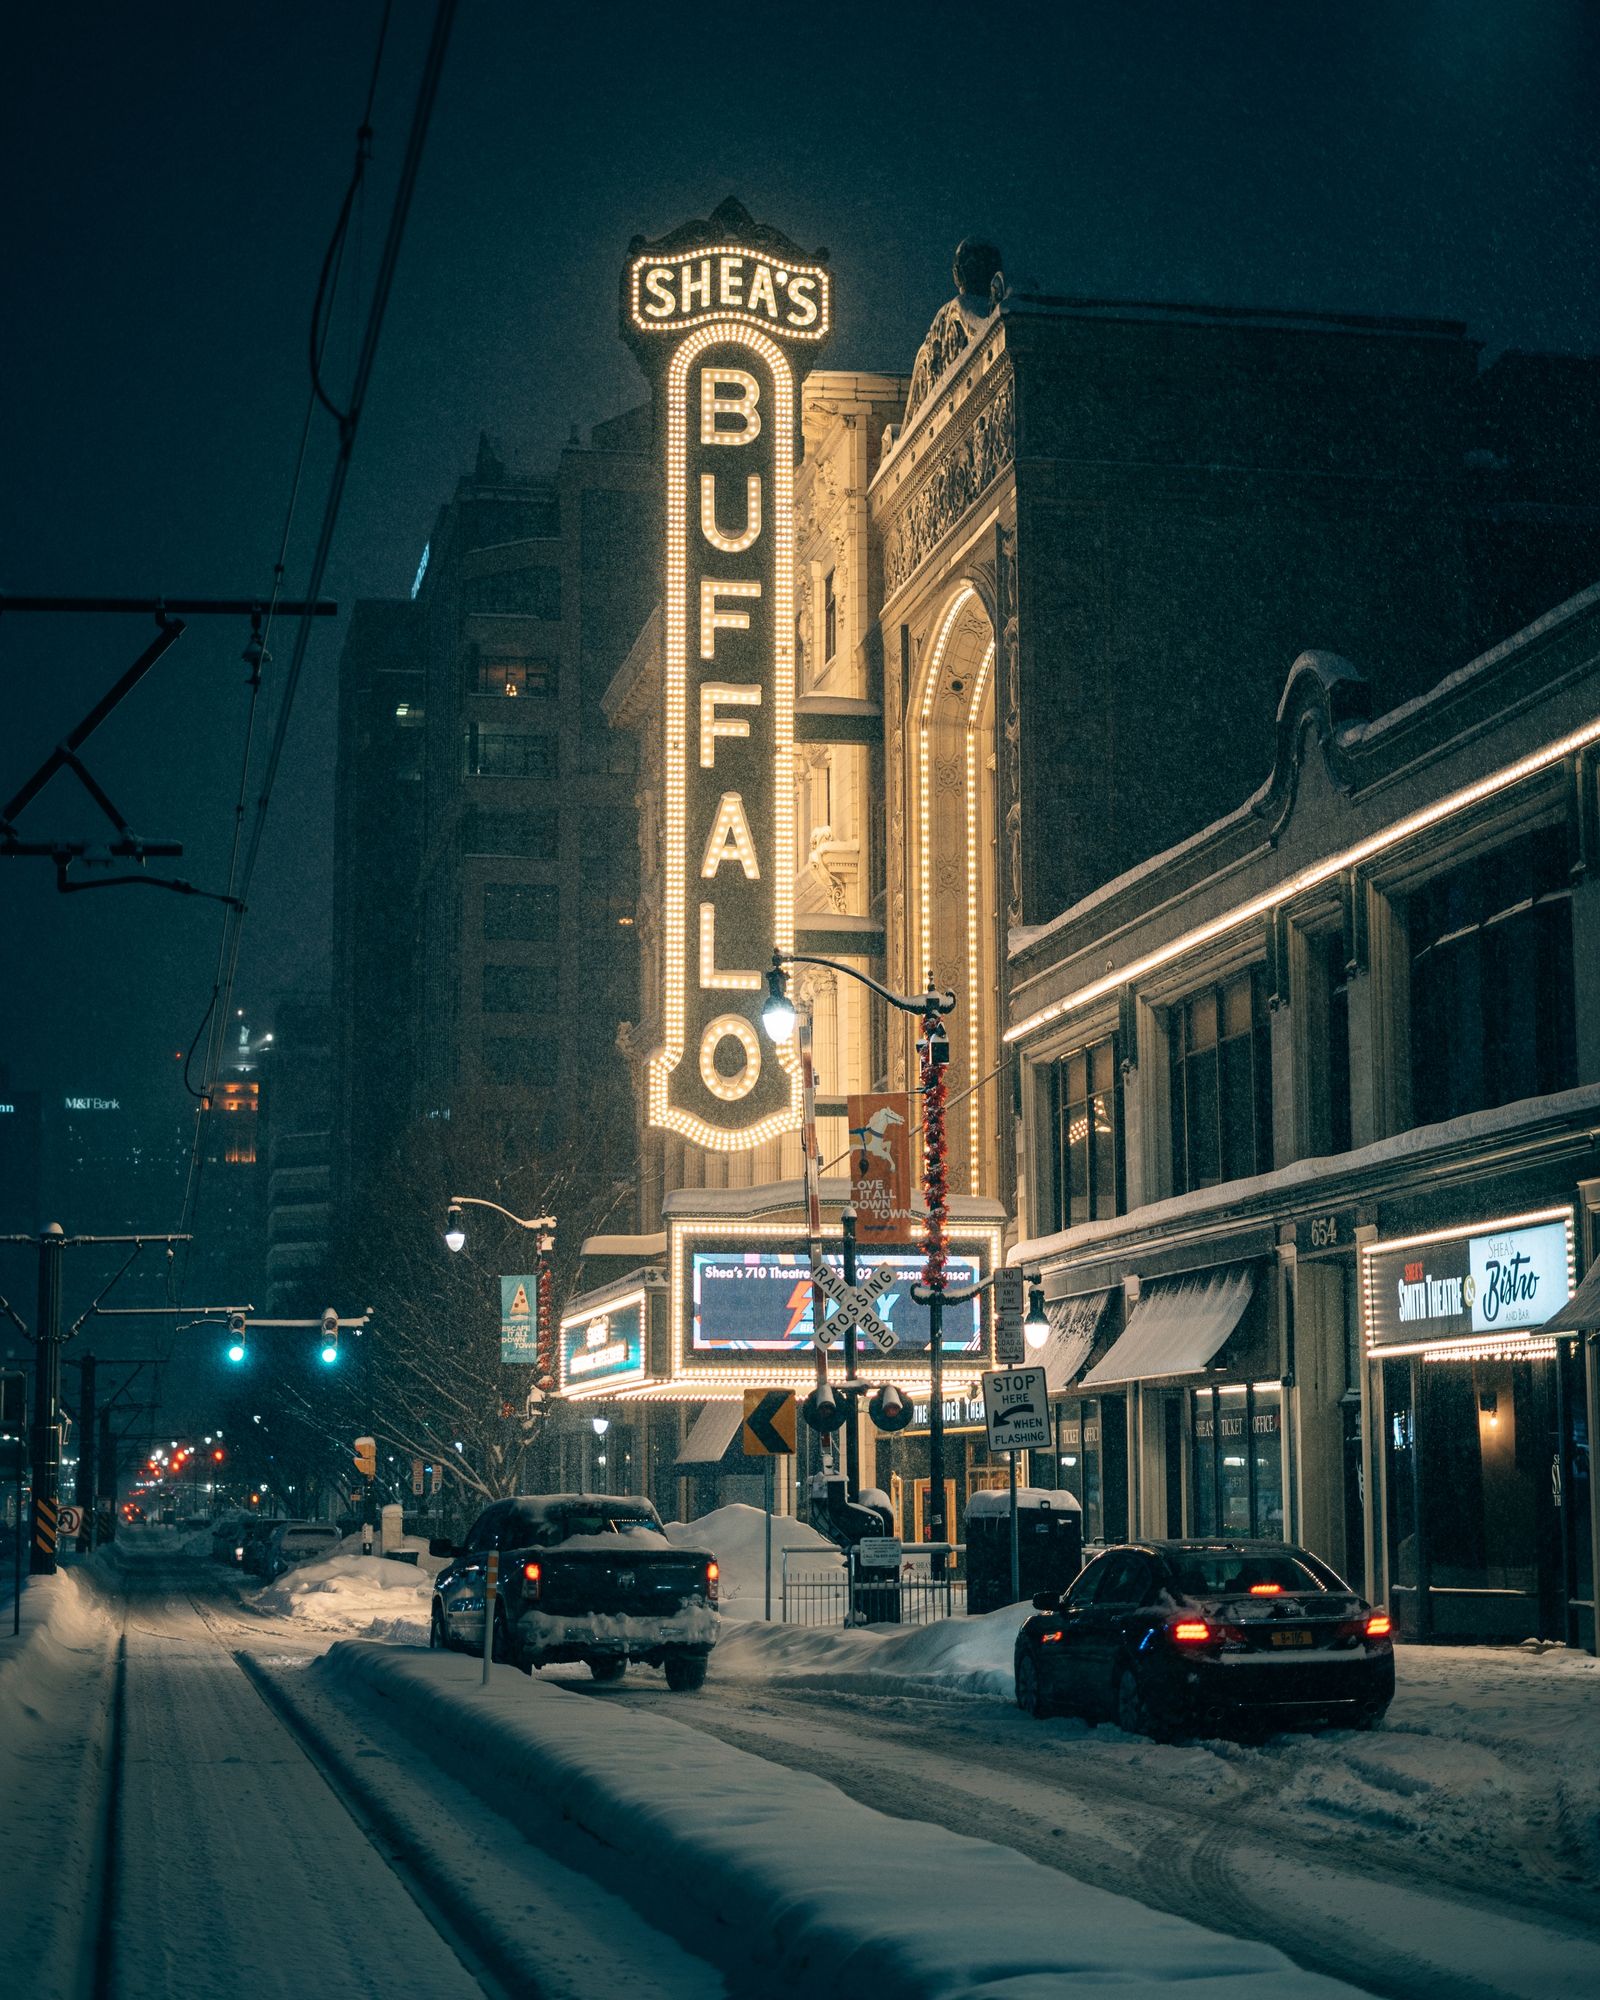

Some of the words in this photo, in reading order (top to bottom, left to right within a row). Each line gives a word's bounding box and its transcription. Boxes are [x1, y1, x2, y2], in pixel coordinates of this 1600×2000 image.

[645, 257, 818, 326] SHEA'S
[700, 367, 762, 1101] BUFFALO
[65, 1098, 91, 1109] M&T
[93, 1098, 119, 1109] Bank
[851, 1180, 883, 1190] LOVE
[861, 1190, 871, 1200] IT
[873, 1189, 896, 1199] ALL
[851, 1200, 890, 1209] DOWN
[873, 1209, 911, 1219] TOWN
[1312, 1216, 1337, 1247] 654
[1488, 1238, 1514, 1259] SHEA'S
[705, 1265, 743, 1279] Shea's
[745, 1267, 767, 1279] 710
[1002, 1271, 1014, 1280] NO
[1483, 1251, 1540, 1322] Bistro
[1398, 1278, 1426, 1322] SMITH
[1426, 1274, 1463, 1319] THEATRE
[815, 1267, 846, 1303] RAIL
[859, 1312, 894, 1350] ROAD
[818, 1270, 892, 1344] CROSSING
[994, 1375, 1036, 1392] STOP
[1002, 1393, 1029, 1404] HERE
[914, 1404, 927, 1423] THE
[964, 1398, 985, 1419] THEA
[1013, 1418, 1043, 1429] WHEN
[1221, 1418, 1243, 1436] TICKET
[1252, 1415, 1274, 1433] OFFICE
[995, 1432, 1045, 1445] FLASHING
